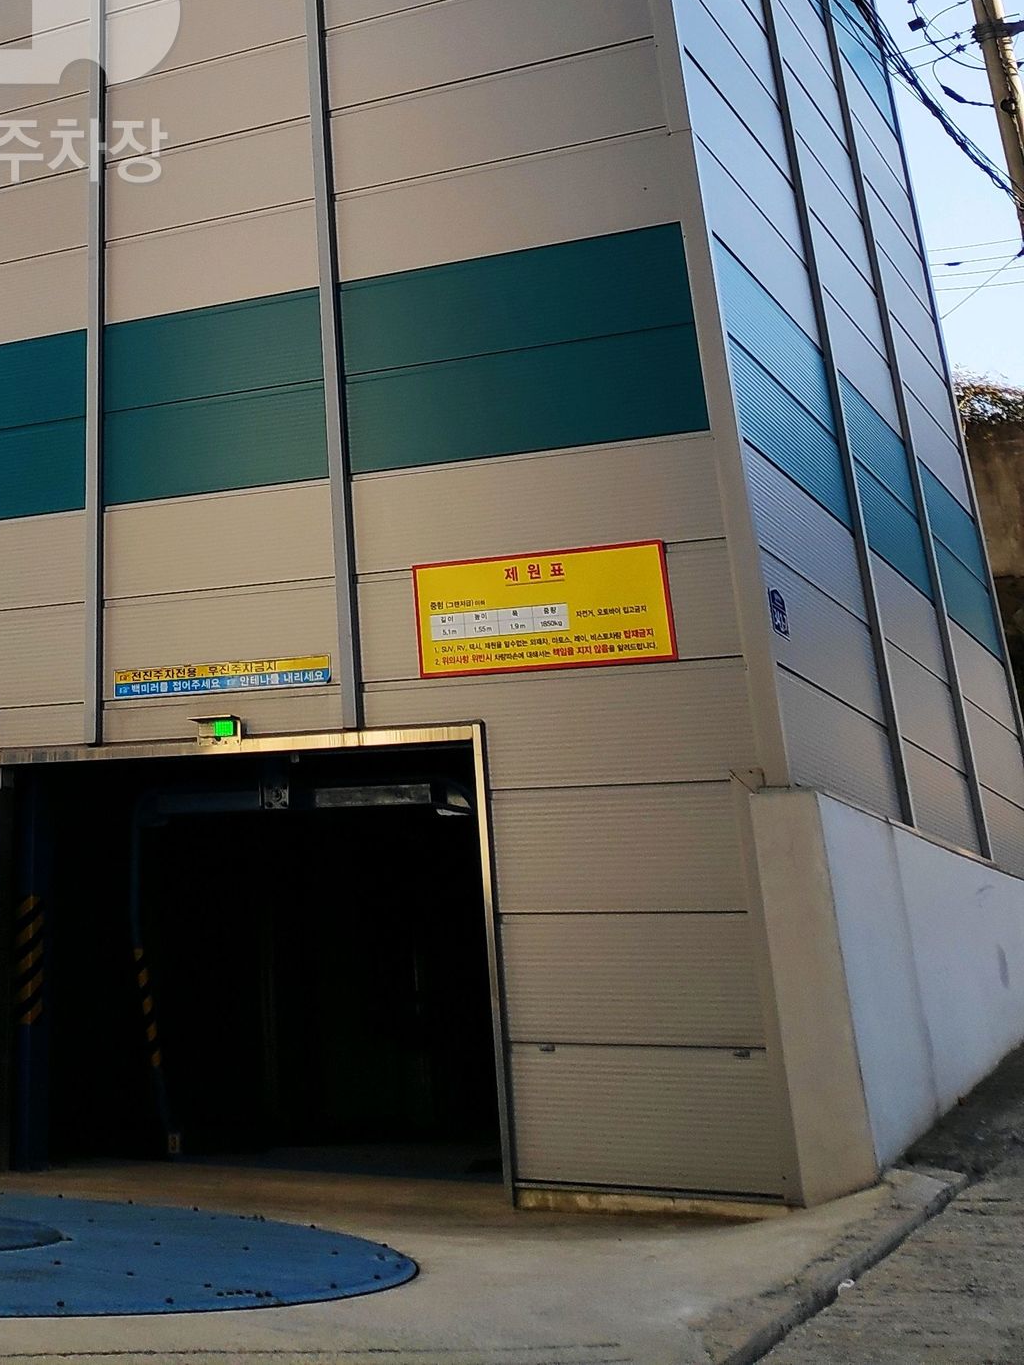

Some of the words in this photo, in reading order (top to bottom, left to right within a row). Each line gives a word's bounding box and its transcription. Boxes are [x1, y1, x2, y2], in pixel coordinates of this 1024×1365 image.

[131, 681, 168, 694] 백미러를
[172, 677, 221, 691] 접어주세요
[239, 673, 279, 687] 안테나를
[283, 670, 324, 683] 내리세요
